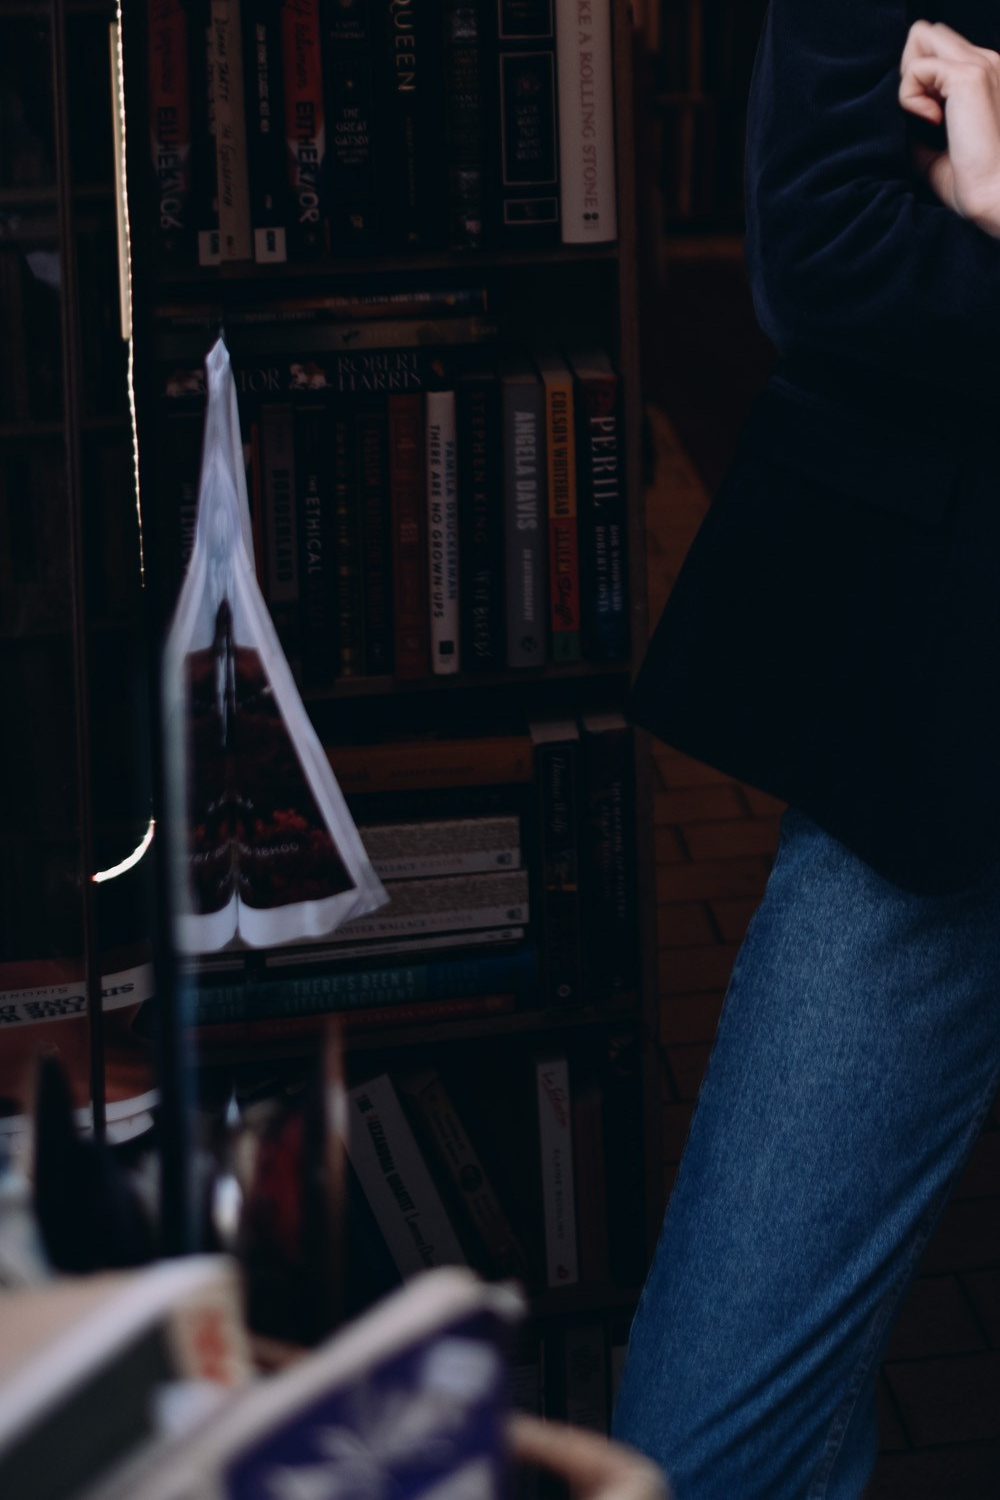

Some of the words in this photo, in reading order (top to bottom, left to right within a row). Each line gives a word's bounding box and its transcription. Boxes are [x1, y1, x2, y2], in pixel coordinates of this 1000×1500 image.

[578, 31, 592, 46] A
[579, 51, 596, 140] ROLLING
[582, 144, 599, 209] STONE
[337, 352, 421, 373] ROBERT
[338, 372, 423, 393] HARRIS
[430, 423, 443, 468] THERE
[514, 411, 537, 477] ANGELA
[552, 390, 570, 442] COLSON
[431, 471, 444, 498] ARE
[445, 441, 458, 497] PAMELA
[553, 446, 573, 516] WHITEHEAD
[590, 415, 618, 508] PERIL
[432, 503, 444, 523] NO
[515, 479, 538, 531] DAVIS
[306, 497, 321, 574] ETHICAL
[447, 501, 461, 600] DRUCKERMAN
[432, 529, 445, 619] GROWN-UPS
[356, 1093, 374, 1113] THE
[367, 1113, 395, 1175] ALEXANDRIA
[386, 1173, 416, 1211] QUARTET
